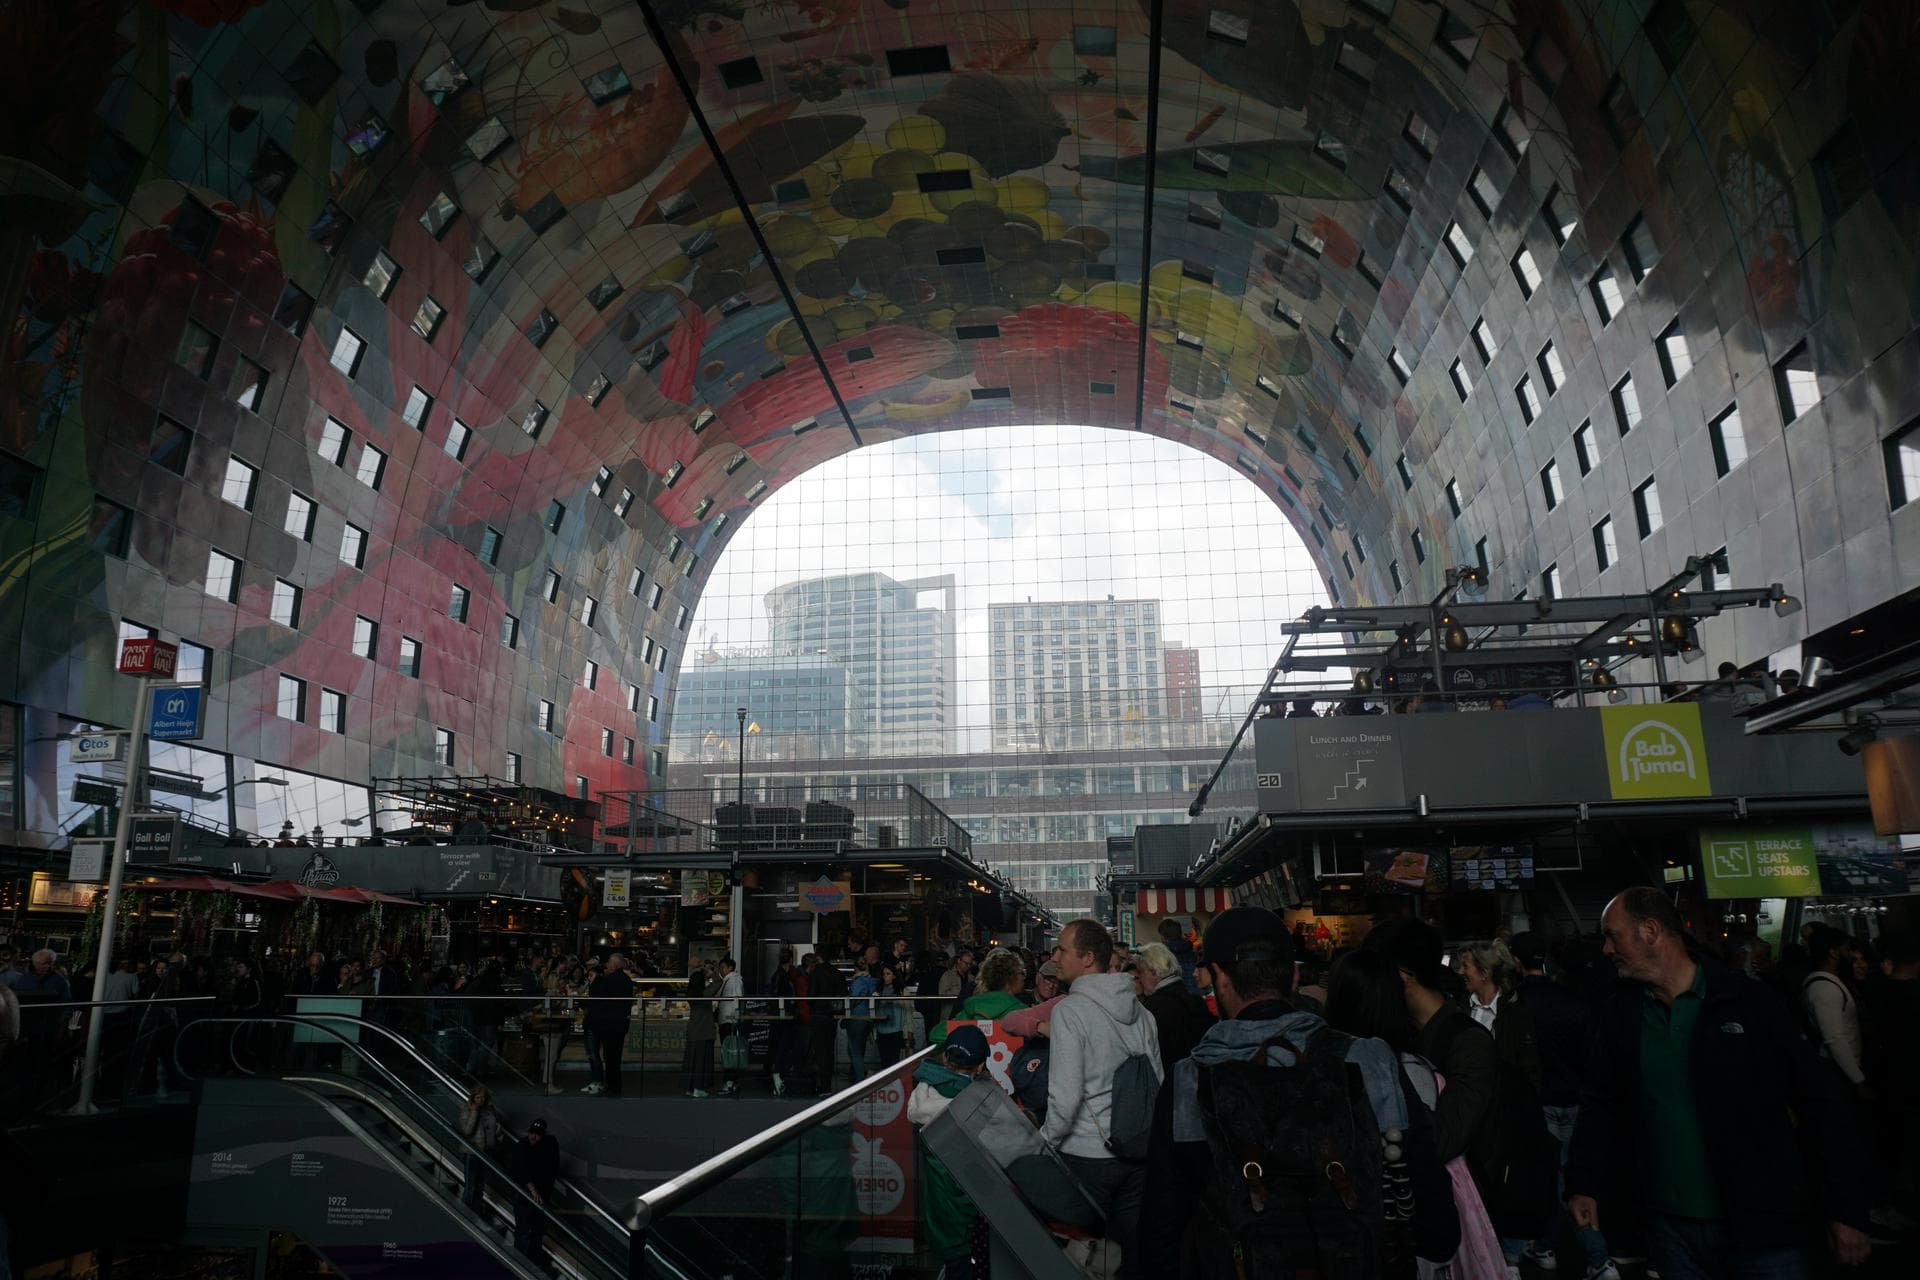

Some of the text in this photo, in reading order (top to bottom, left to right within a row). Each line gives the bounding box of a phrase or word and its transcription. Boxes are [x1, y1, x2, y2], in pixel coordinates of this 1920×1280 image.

[153, 719, 176, 729] Albert
[153, 728, 193, 738] Supermarkt
[1309, 733, 1393, 744] LUNCH AND DINNER
[79, 738, 109, 753] etos
[1636, 733, 1676, 758] Bab
[1630, 757, 1686, 782] Tuma
[1257, 774, 1280, 787] 20
[135, 832, 171, 843] Gall Gall
[1755, 838, 1803, 851] TERRACE
[1756, 852, 1790, 864] SEATS
[1758, 864, 1810, 877] UPSTAIRS
[211, 1152, 233, 1162] 2014
[327, 1196, 348, 1206] 1972
